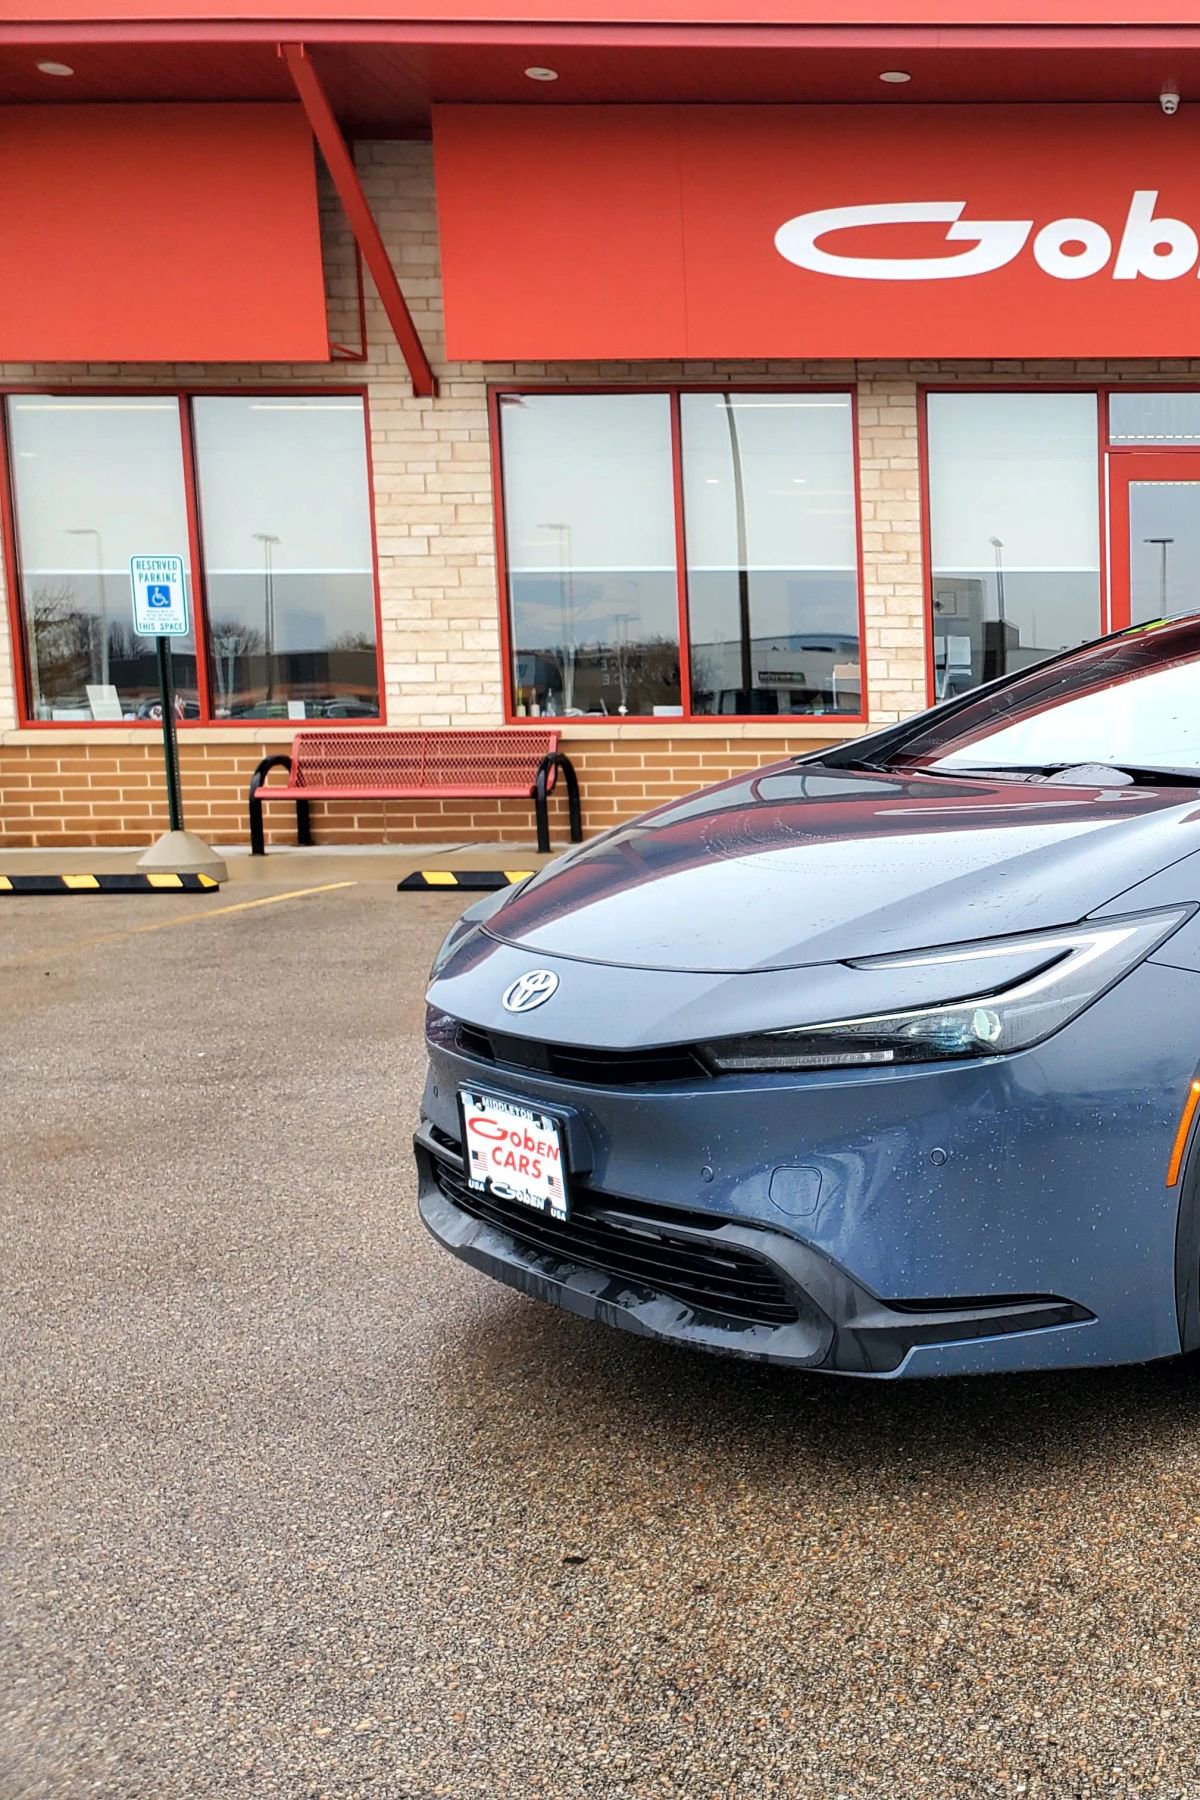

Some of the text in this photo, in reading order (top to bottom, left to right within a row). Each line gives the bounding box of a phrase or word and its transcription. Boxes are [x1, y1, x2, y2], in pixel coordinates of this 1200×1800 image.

[136, 560, 178, 571] RESERVED
[139, 572, 177, 583] PARKING
[139, 622, 184, 631] THIS SPACE
[482, 1097, 534, 1120] MIDDLETON
[491, 1146, 543, 1179] CARS
[468, 1179, 486, 1192] USA
[550, 1207, 567, 1222] USA
